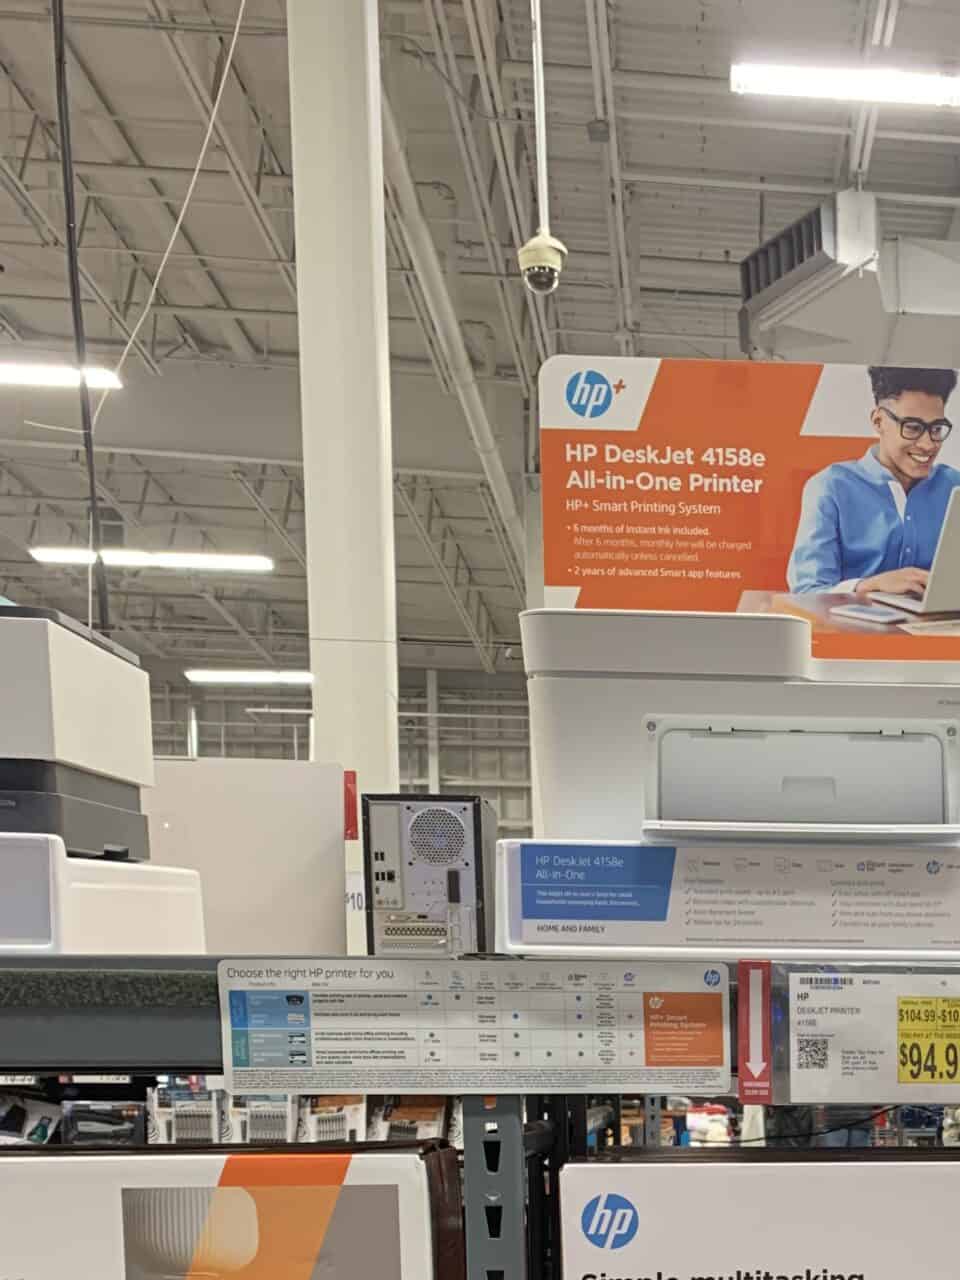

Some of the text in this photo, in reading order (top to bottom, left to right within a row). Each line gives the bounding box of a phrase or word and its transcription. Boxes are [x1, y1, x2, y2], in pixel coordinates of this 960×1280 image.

[565, 443, 766, 467] HP DeskJet 4158e
[566, 470, 763, 493] All-in-One Printer
[566, 499, 720, 516] HP+ Smart Printing System
[580, 525, 614, 533] months
[616, 525, 624, 533] of
[582, 568, 605, 577] years
[607, 567, 615, 576] of
[618, 568, 658, 577] advanced
[660, 568, 686, 577] Smart
[688, 570, 704, 579] app
[535, 855, 624, 868] HP DeskJet 4158e
[535, 869, 585, 880] All-in-One
[536, 924, 559, 932] HOME
[579, 925, 605, 933] FAMILY
[226, 968, 264, 978] Choose
[266, 968, 282, 978] the
[284, 968, 306, 980] right
[309, 968, 323, 977] HP
[325, 968, 357, 980] printer
[359, 968, 373, 978] for
[797, 992, 809, 1001] HP
[898, 1009, 936, 1022] $104.99
[581, 1193, 639, 1250] hp
